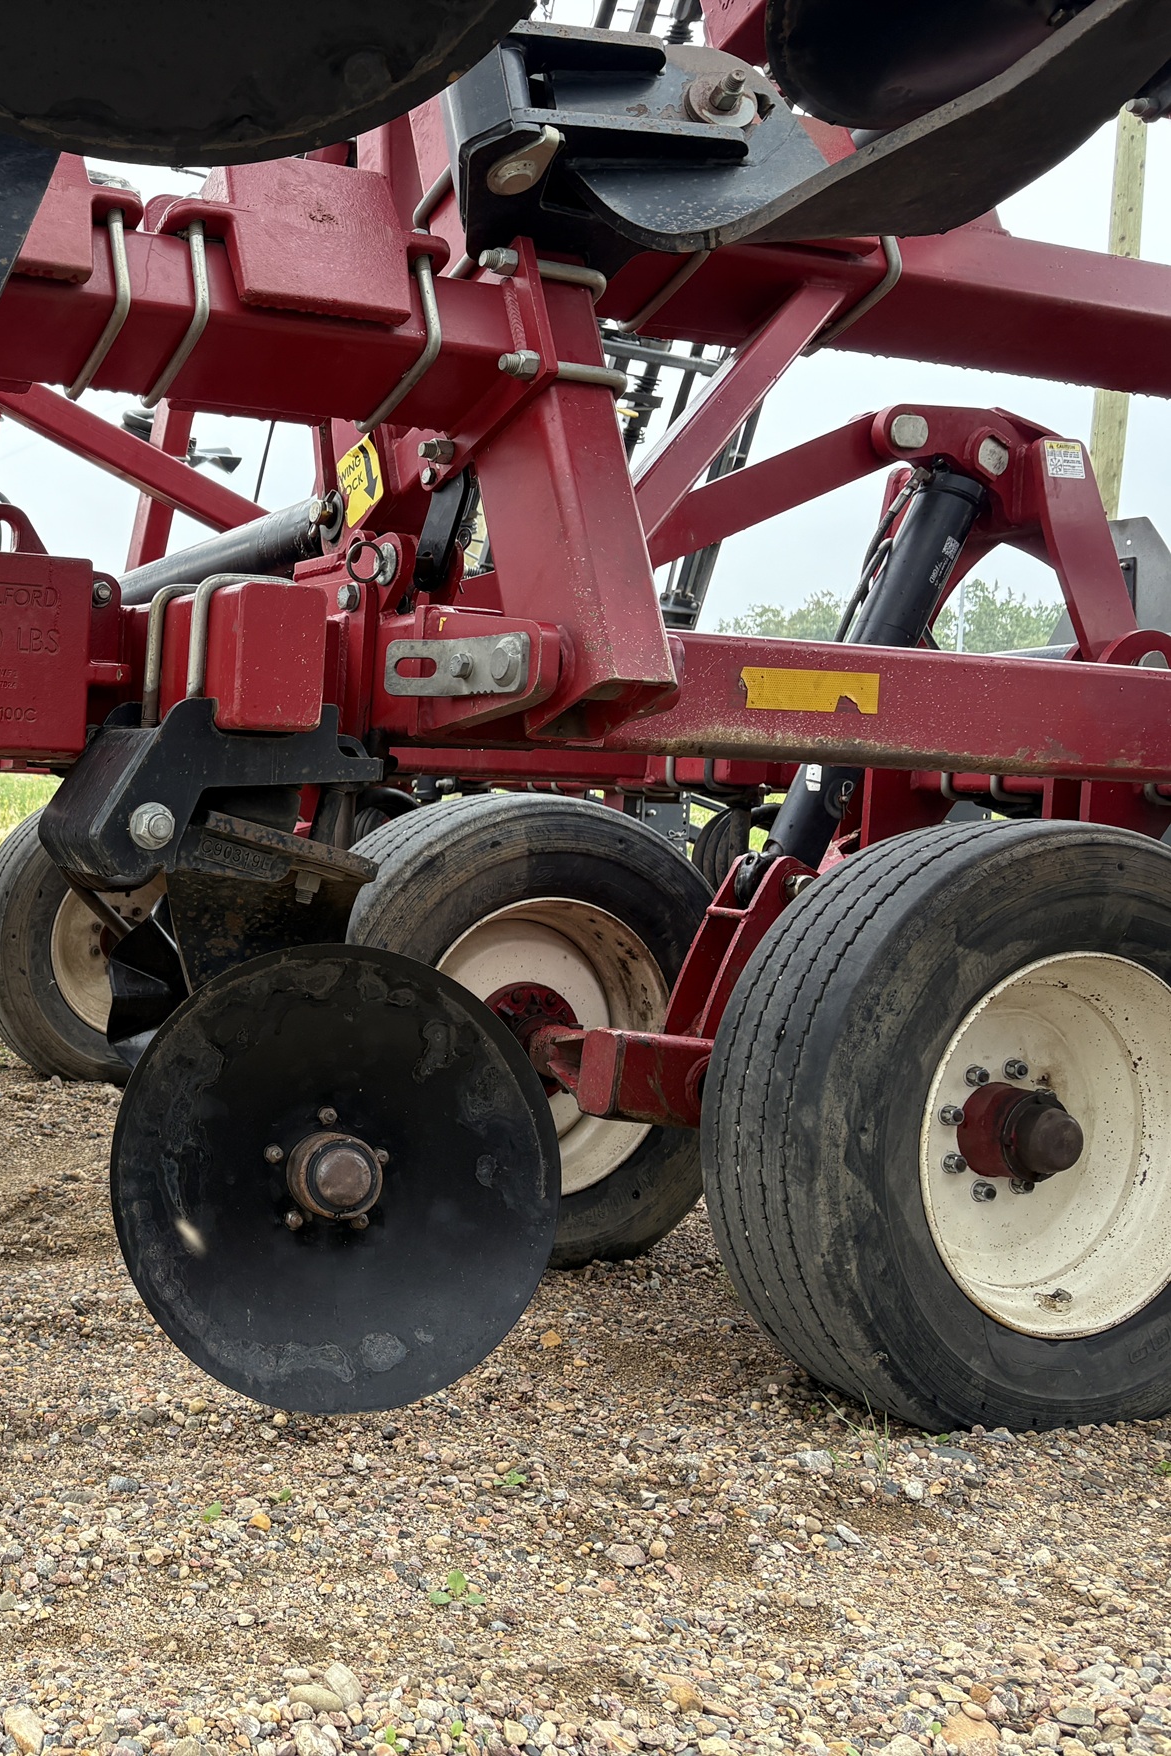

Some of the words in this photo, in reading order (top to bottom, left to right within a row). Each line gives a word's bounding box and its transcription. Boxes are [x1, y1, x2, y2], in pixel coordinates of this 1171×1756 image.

[346, 471, 364, 496] OCK
[17, 626, 61, 656] LBS
[201, 838, 268, 871] C90319L
